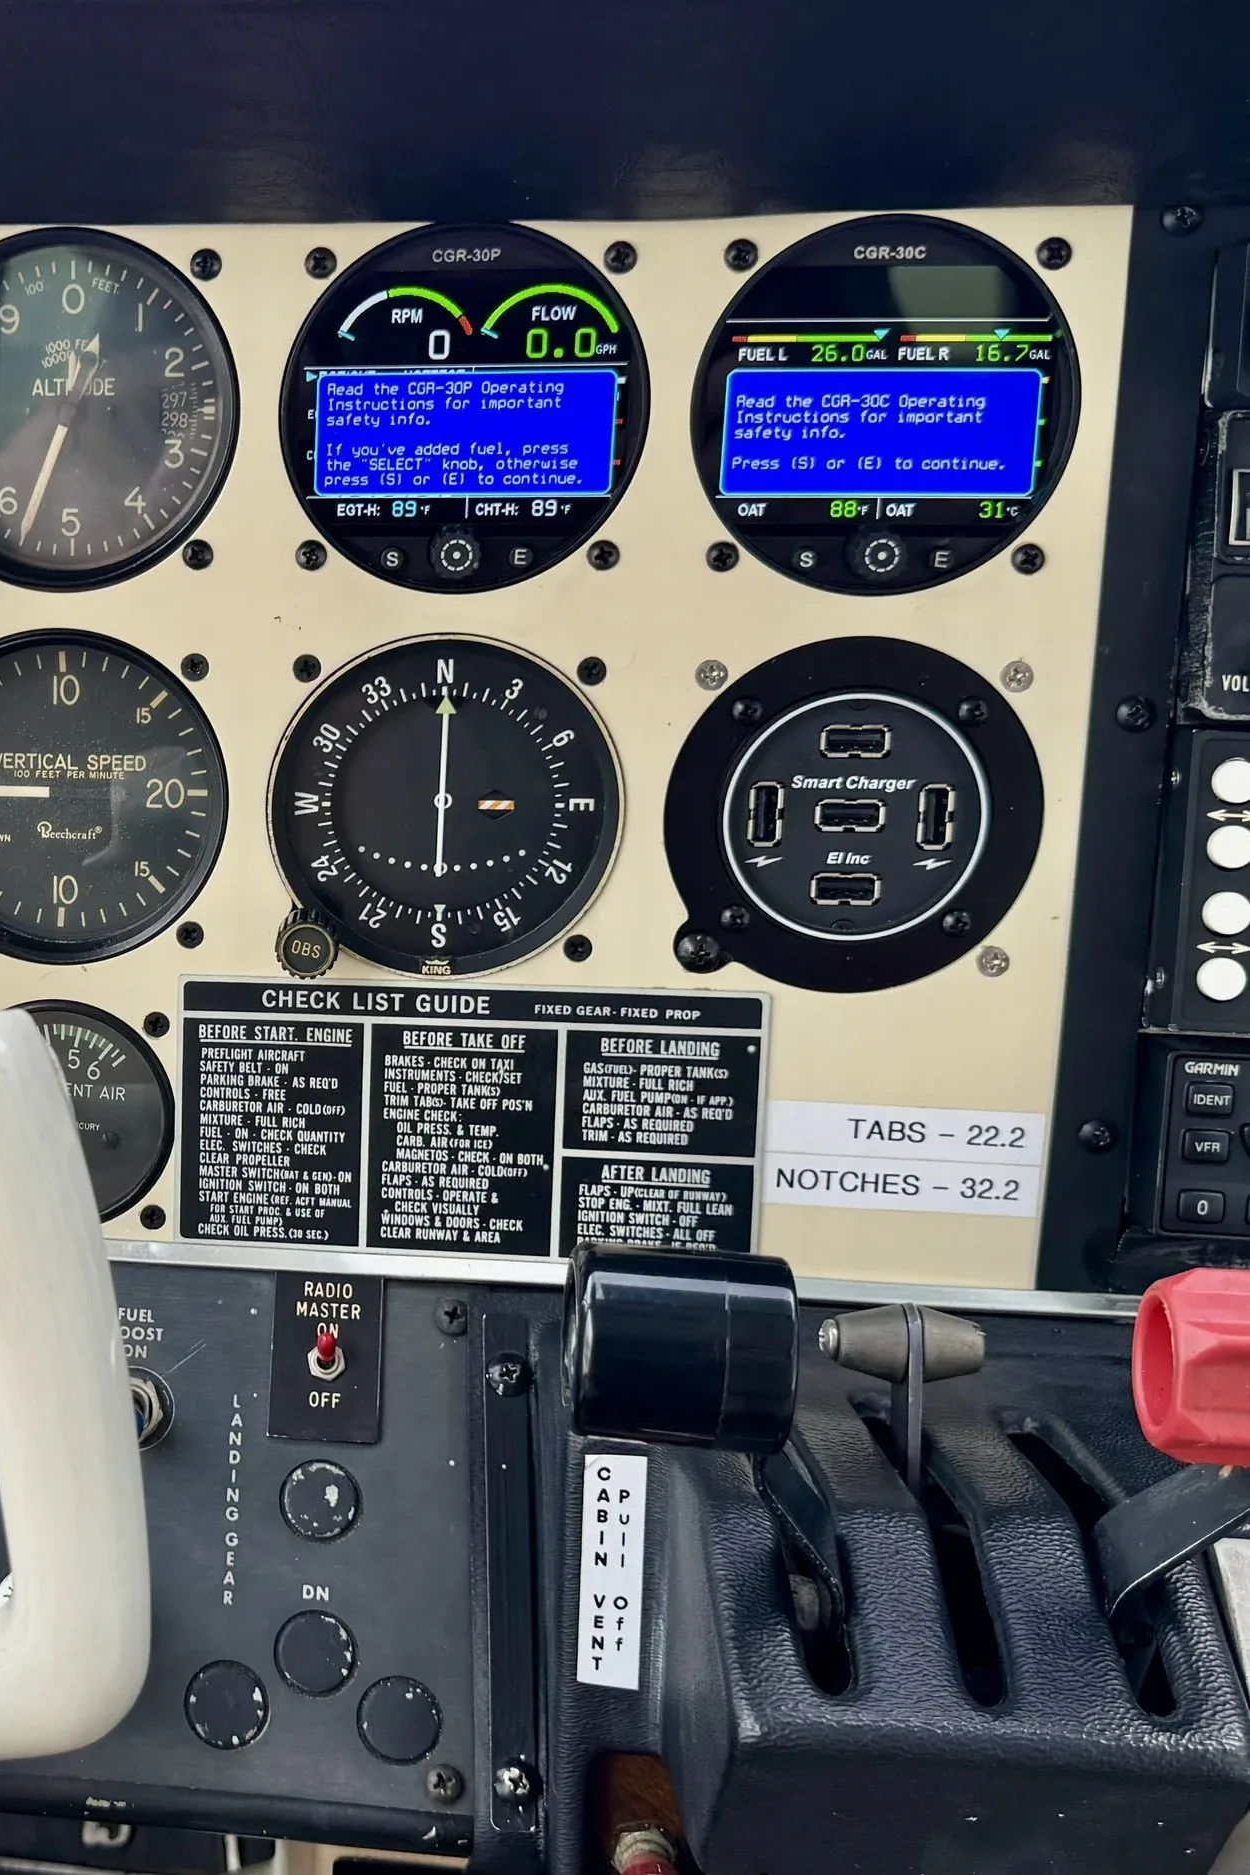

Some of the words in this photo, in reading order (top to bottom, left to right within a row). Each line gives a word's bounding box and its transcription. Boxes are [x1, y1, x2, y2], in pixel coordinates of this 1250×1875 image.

[432, 249, 500, 263] CGR-30P
[854, 246, 926, 259] CGR-30C
[92, 278, 119, 293] FEET
[62, 284, 84, 314] 0
[0, 305, 19, 334] 9
[392, 308, 422, 324] RPM
[532, 305, 576, 321] FLOW
[429, 329, 450, 360] 0
[526, 328, 596, 359] 0.0
[738, 348, 773, 361] FUEL
[774, 348, 788, 361] L
[811, 344, 865, 362] 26.0
[898, 347, 934, 360] FUEL
[938, 347, 949, 360] R
[975, 344, 1029, 362] 16.7
[165, 348, 184, 377] 2
[327, 383, 365, 396] Read
[374, 383, 398, 395] the
[408, 382, 472, 395] CGR-30P
[482, 382, 564, 395] Operating
[327, 398, 434, 411] Instructions
[445, 397, 469, 410] for
[482, 398, 561, 410] important
[327, 414, 381, 427] safety
[390, 413, 430, 426] info.
[165, 439, 184, 468] 3
[732, 457, 779, 470] Press
[792, 457, 815, 470] (S)
[827, 458, 845, 469] or
[858, 457, 881, 470] (E)
[895, 457, 912, 470] to
[921, 457, 1005, 470] continue.
[125, 486, 146, 514] 4
[475, 503, 519, 516] CHT-H:
[532, 500, 557, 516] 89
[337, 504, 380, 517] EGT-H:
[392, 501, 416, 517] 89
[738, 503, 767, 517] OAT
[830, 501, 857, 518] 88
[886, 503, 916, 517] OAT
[979, 501, 1004, 518] 31
[61, 508, 80, 536] 5
[437, 659, 453, 683] N
[53, 675, 79, 705] 10
[87, 755, 146, 772] SPEED
[14, 770, 30, 778] 100
[36, 770, 60, 778] FEET
[67, 771, 85, 779] PER
[89, 771, 124, 780] MINUTE
[791, 775, 843, 789] Smart
[846, 776, 918, 792] Charger
[146, 779, 184, 808] 20
[845, 852, 871, 864] Inc
[53, 875, 78, 904] 10
[291, 940, 321, 958] OBS
[422, 965, 451, 975] KING
[261, 989, 340, 1010] CHECK
[353, 991, 405, 1012] LIST
[416, 994, 491, 1015] GUIDE
[535, 1004, 571, 1015] FIXED
[621, 1008, 658, 1018] FIXED
[666, 1010, 701, 1020] PROP
[199, 1024, 246, 1039] BEFORE
[307, 1028, 352, 1043] ENGINE
[404, 1031, 453, 1047] BEFORE
[461, 1033, 493, 1048] TAKE
[501, 1034, 526, 1049] OFF
[202, 1048, 252, 1060] PREFLIGHT
[258, 1050, 305, 1061] AIRCRAFT
[601, 1038, 652, 1054] BEFORE
[660, 1040, 720, 1057] LANDING
[1185, 1062, 1239, 1076] GARMIN
[1194, 1094, 1231, 1106] IDENT
[848, 1118, 926, 1143] TABS
[966, 1124, 1025, 1148] 22.2
[1195, 1142, 1220, 1152] VFR
[601, 1165, 643, 1181] AFTER
[652, 1167, 711, 1184] LANDING
[775, 1167, 920, 1196] NOTCHES
[960, 1177, 1020, 1201] 32.2
[1197, 1200, 1208, 1215] 0
[304, 1281, 352, 1298] RADIO
[296, 1301, 361, 1319] MASTER
[309, 1392, 340, 1408] OFF
[302, 1584, 329, 1601] DN
